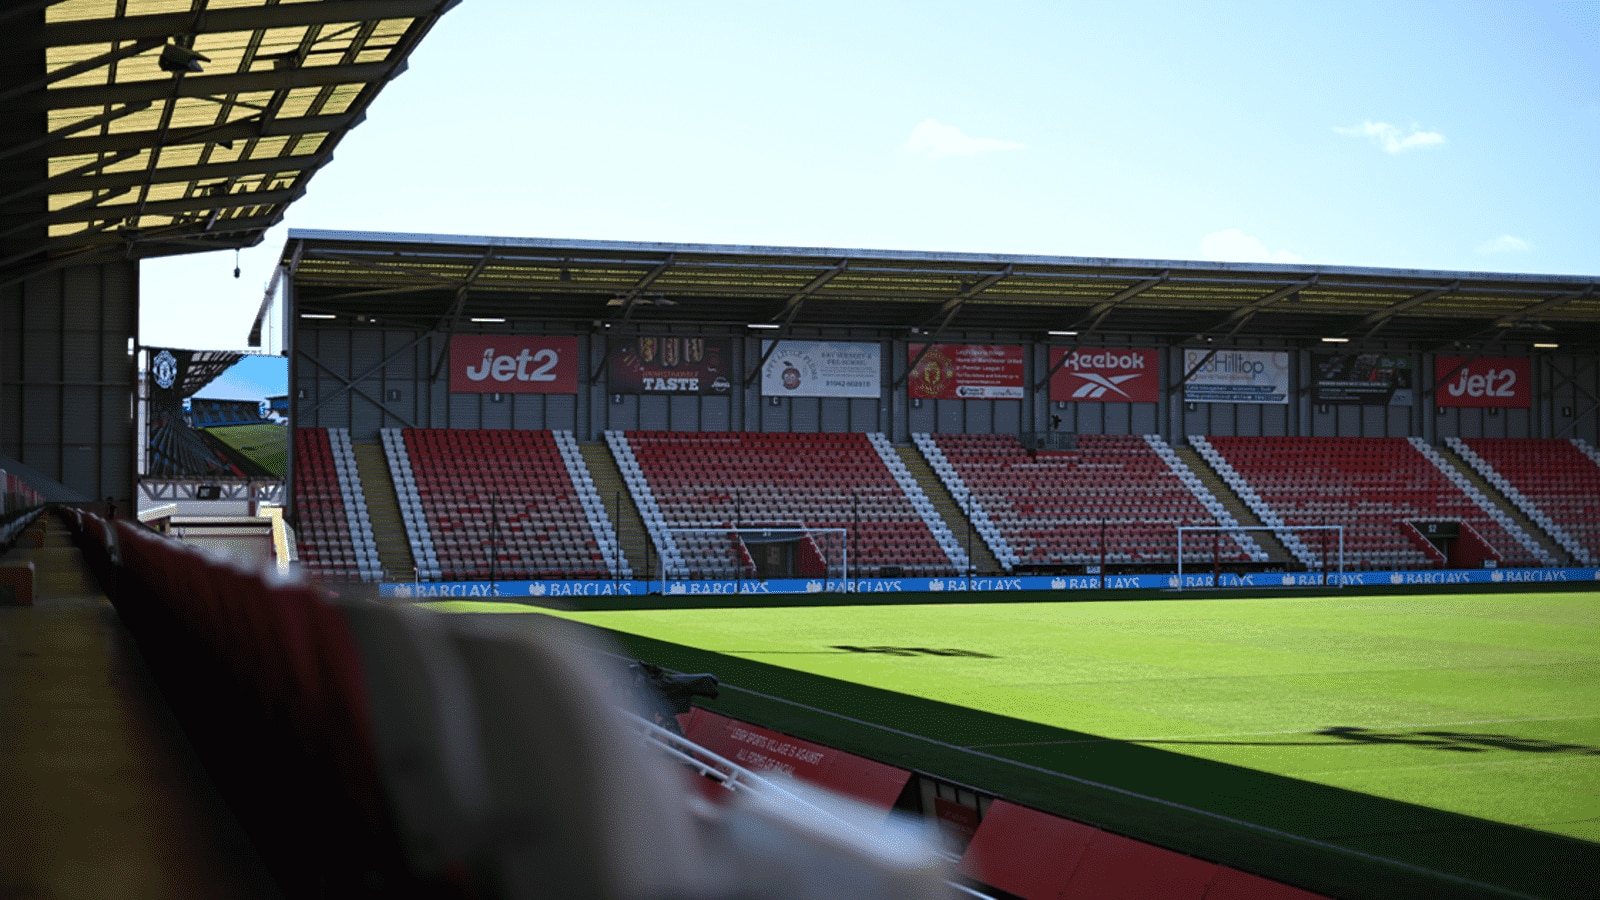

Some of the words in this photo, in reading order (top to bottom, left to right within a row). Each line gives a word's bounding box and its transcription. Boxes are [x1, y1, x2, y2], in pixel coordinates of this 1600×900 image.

[466, 348, 560, 381] Jet2
[1063, 351, 1145, 371] Reebok
[1215, 353, 1264, 379] Hilltop
[643, 378, 699, 391] TASTE
[1448, 367, 1517, 397] Jet2
[1406, 572, 1470, 584] BARCLAYS
[1506, 570, 1567, 582] BARCLAYS
[416, 583, 502, 598] BARCLAYS
[549, 582, 633, 597] BARCLAYS
[690, 581, 770, 594] BARCLAYS
[826, 580, 903, 593] BARCLAYS
[947, 579, 1023, 591] BARCLAYS
